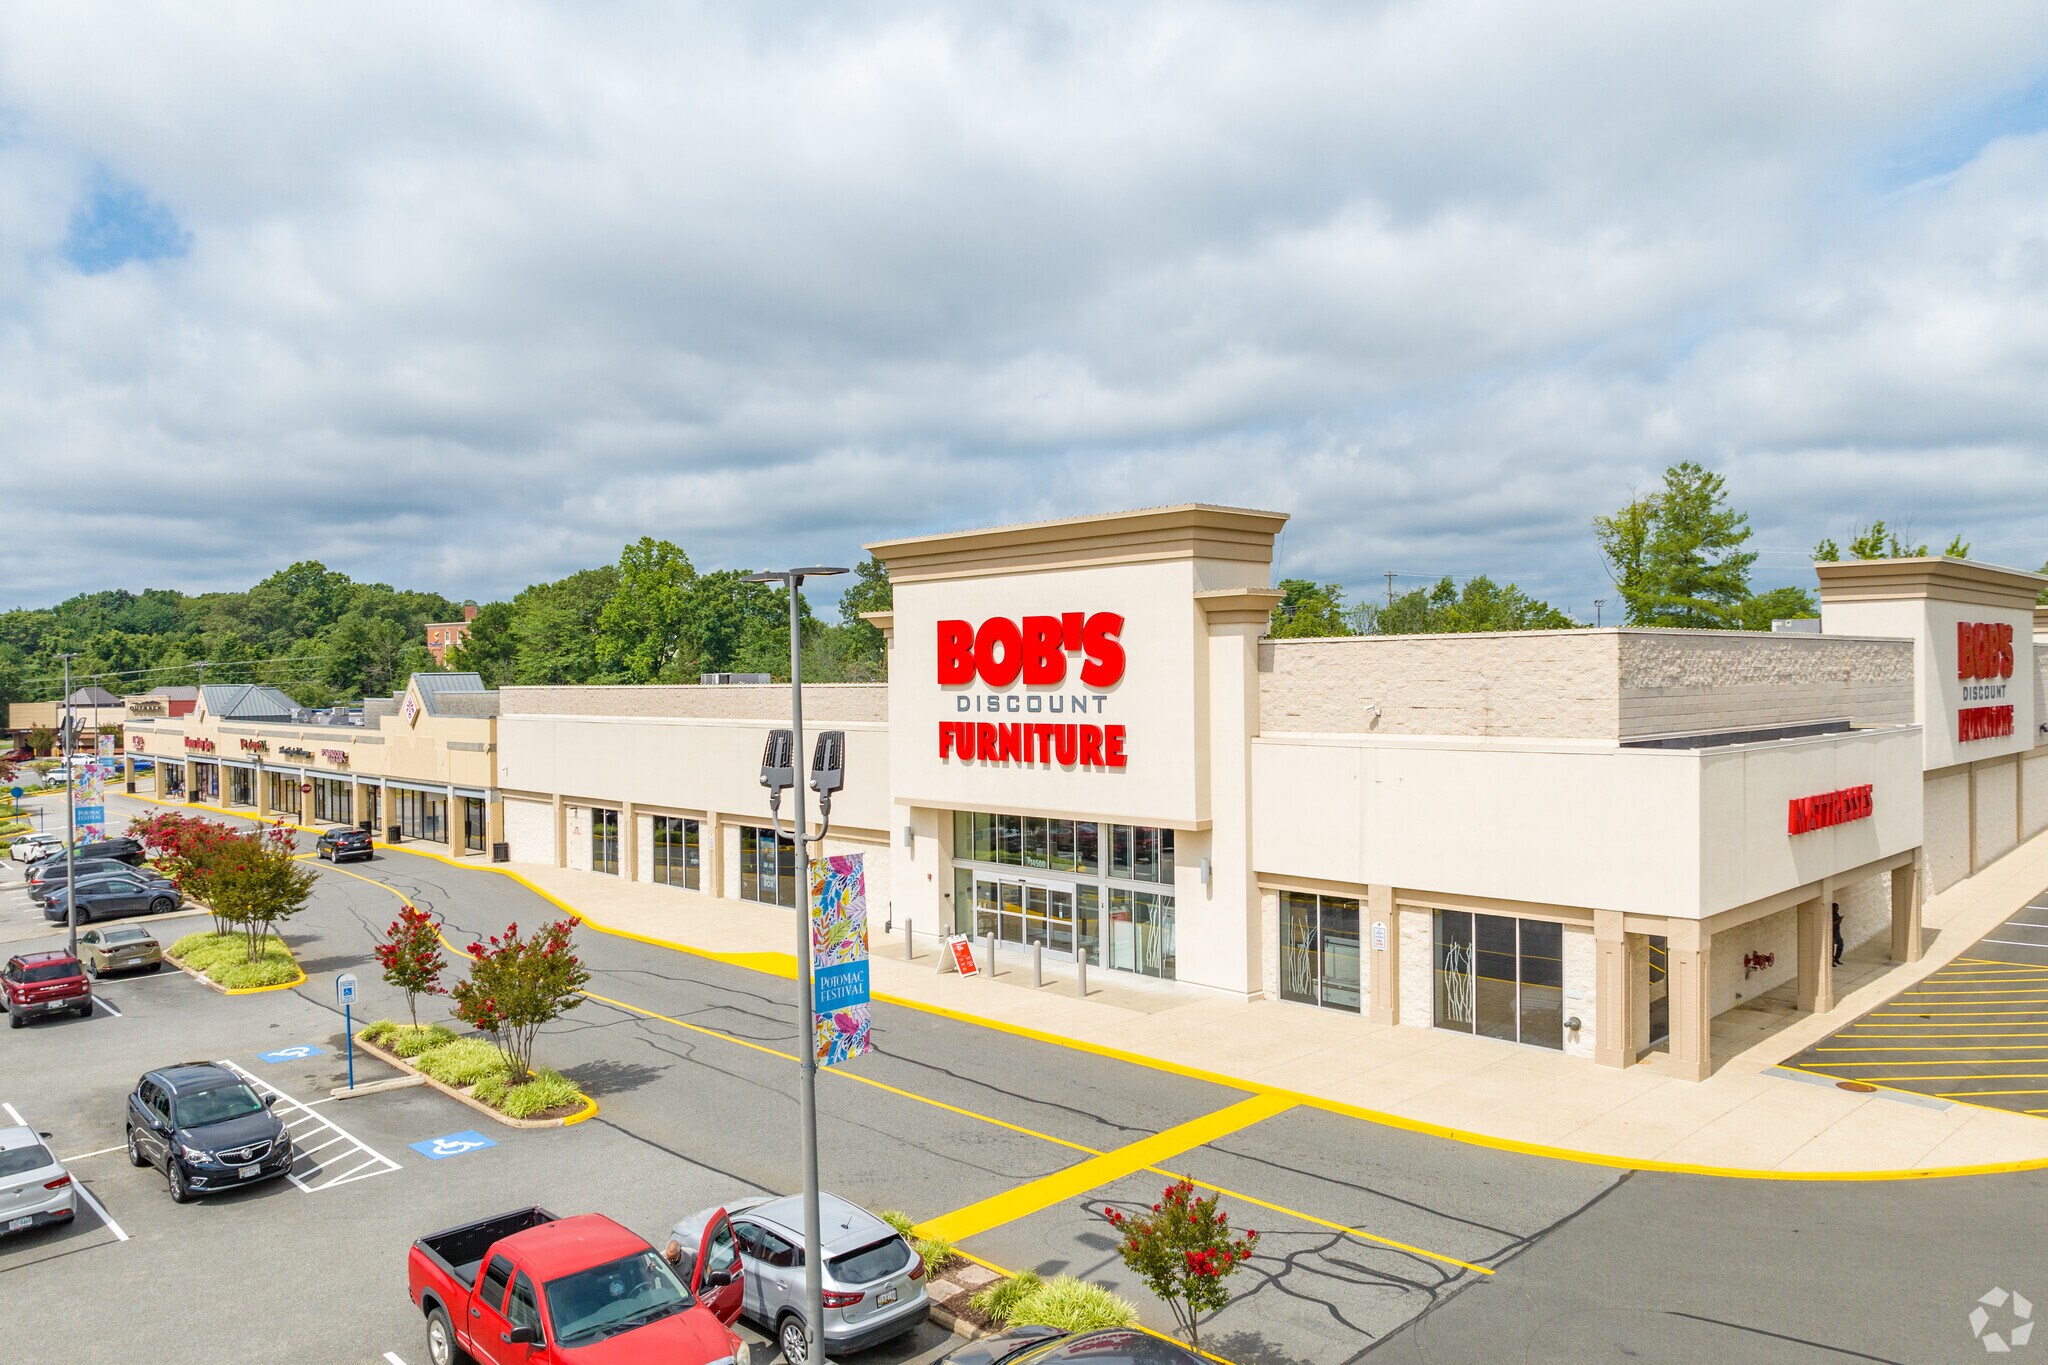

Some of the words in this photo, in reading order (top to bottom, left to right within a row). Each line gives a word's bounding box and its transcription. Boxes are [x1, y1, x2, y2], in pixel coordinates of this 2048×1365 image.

[937, 611, 1126, 687] BOB'S
[1957, 621, 2014, 680] BOB'S
[1963, 685, 2006, 701] DISCOUNT
[956, 695, 1108, 714] DISCOUNT
[938, 721, 1128, 767] FURNITURE
[820, 970, 864, 990] POTOMAC
[820, 983, 865, 1003] FESTIVAL
